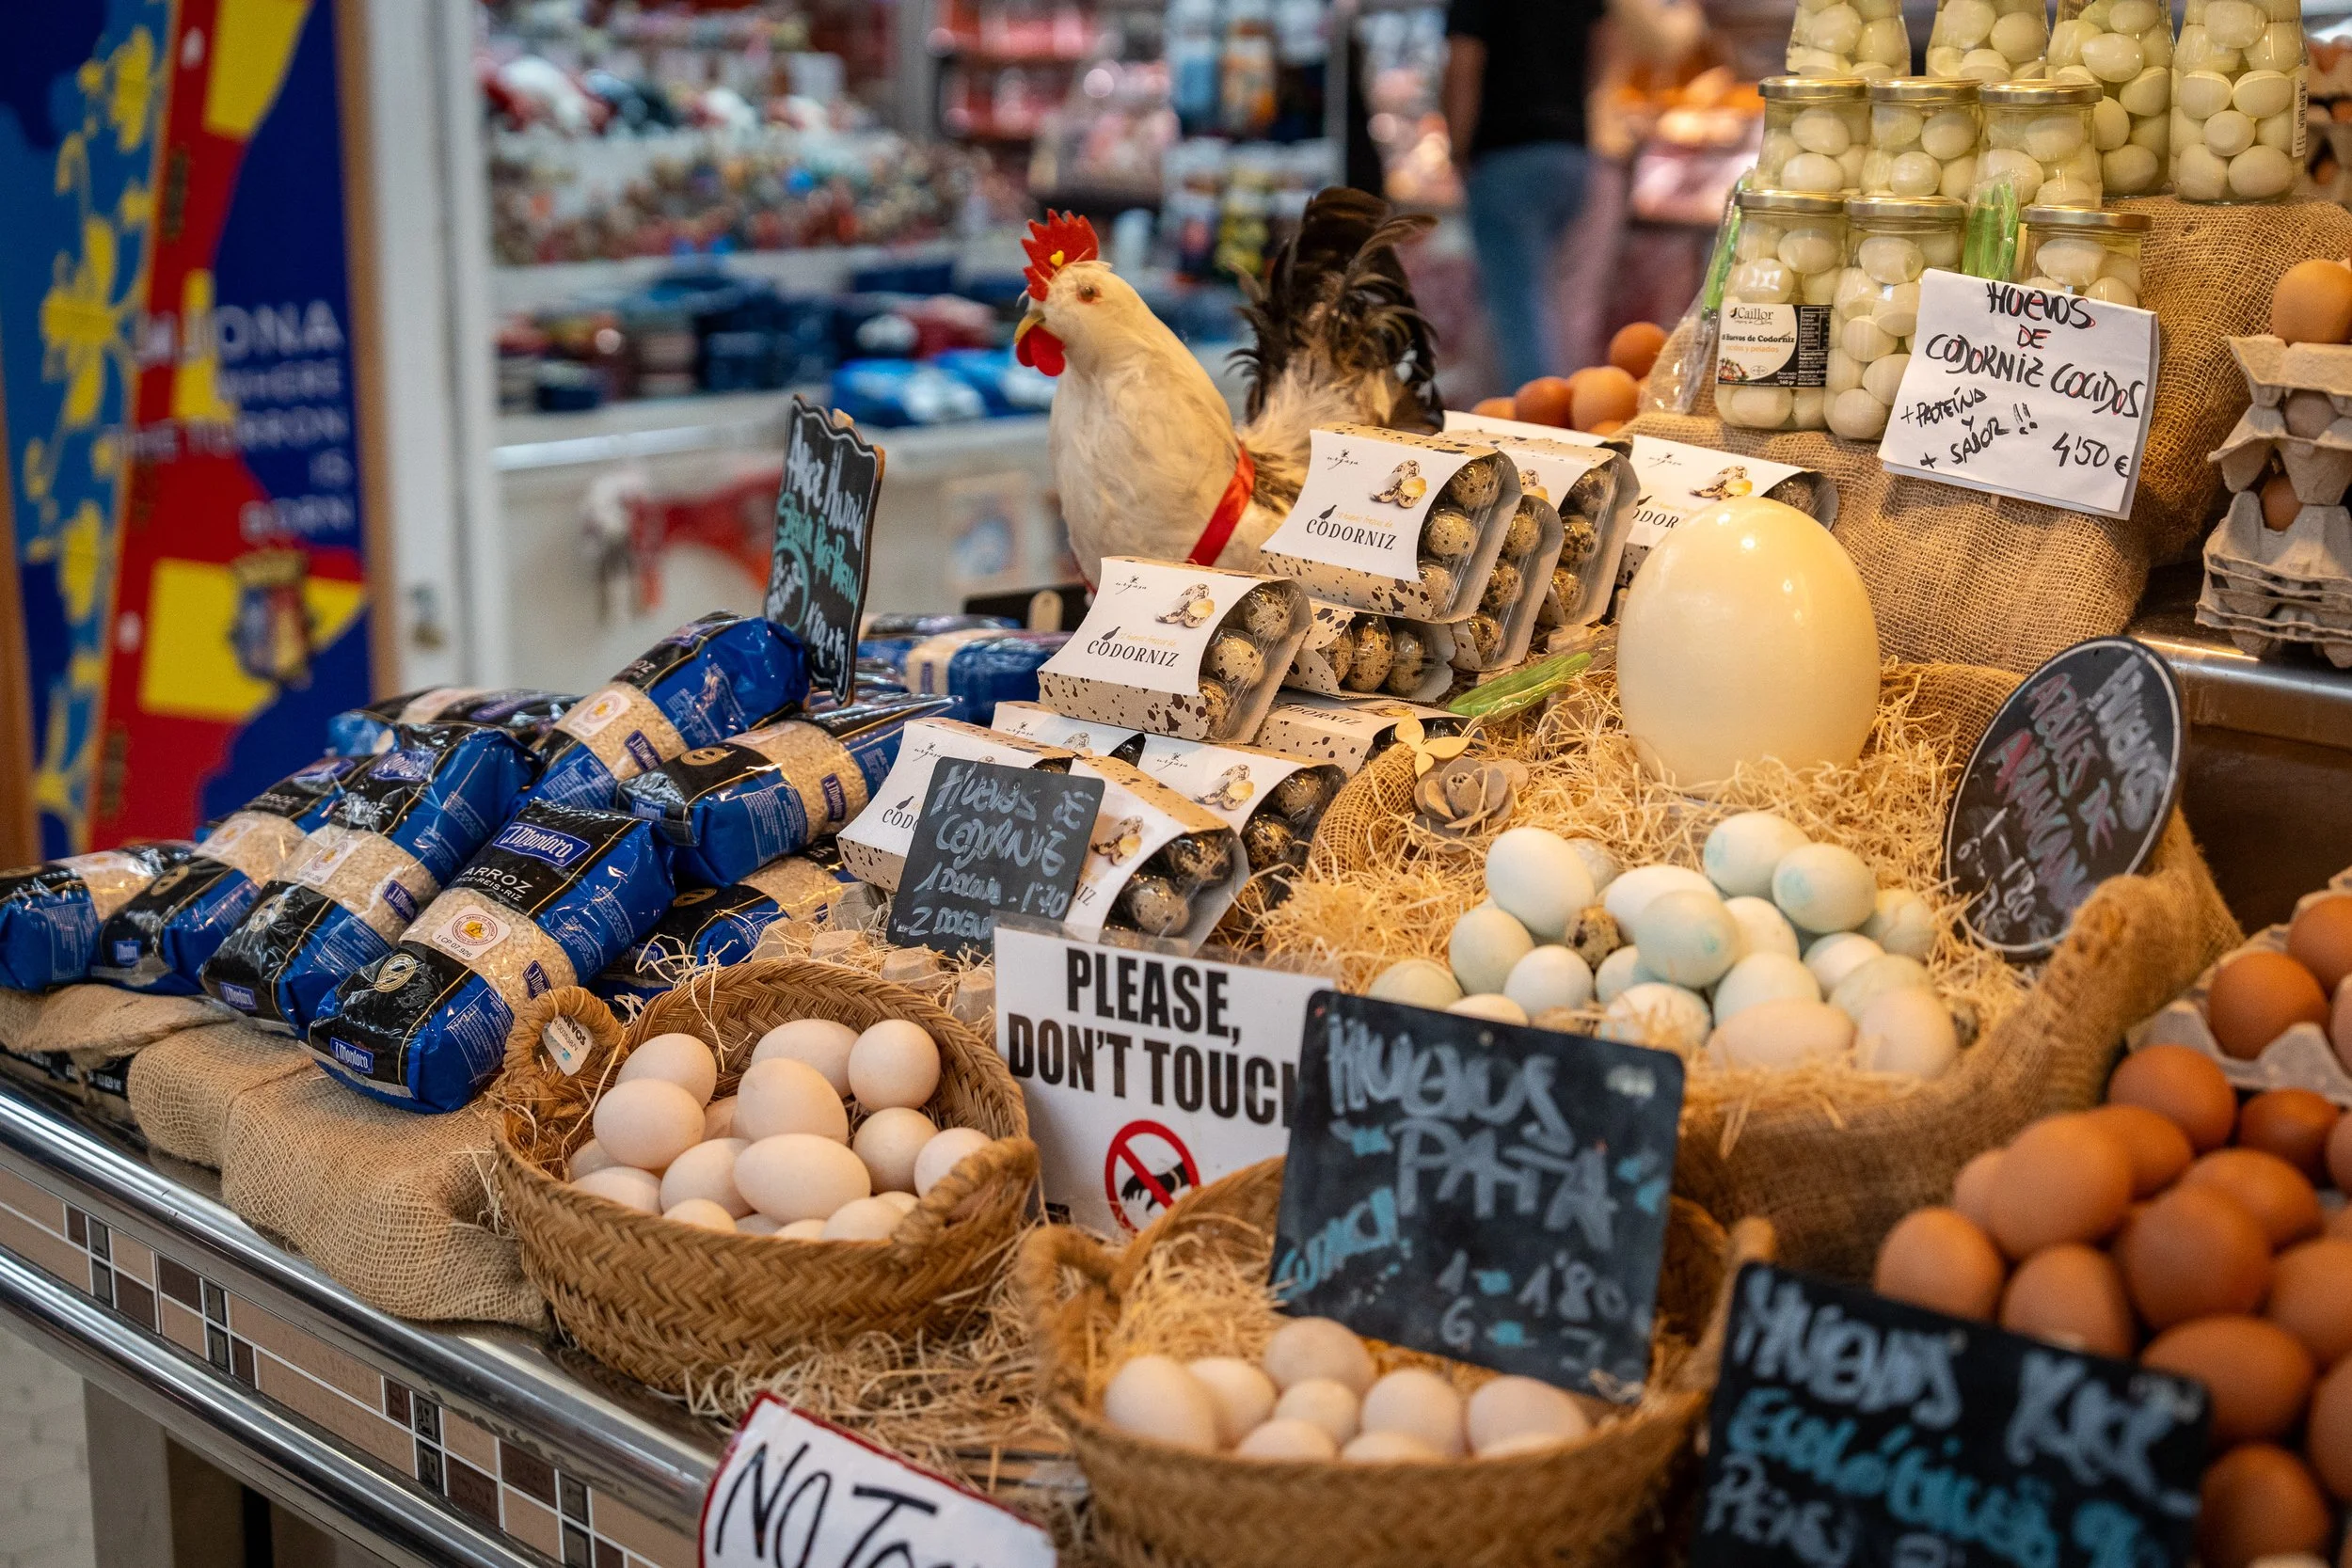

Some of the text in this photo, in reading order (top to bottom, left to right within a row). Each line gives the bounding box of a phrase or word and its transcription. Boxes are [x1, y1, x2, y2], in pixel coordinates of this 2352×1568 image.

[1738, 306, 1773, 319] Caillor
[1987, 282, 2096, 329] HUEVOS
[1747, 334, 1756, 342] de
[1757, 335, 1795, 343] Codorniz
[2017, 324, 2052, 349] DE
[1926, 333, 2145, 419] CODORNIZ COCIDOS
[1306, 518, 1397, 550] CODORNIZ
[1087, 640, 1180, 668] CODORNIZ
[1277, 705, 1362, 725] ODORNIZ
[462, 866, 533, 894] ARROZ
[1067, 947, 1242, 1047] PLEASE,
[564, 1016, 586, 1047] UEVOS
[1008, 1013, 1133, 1099] DON'T
[714, 1442, 832, 1568] NO
